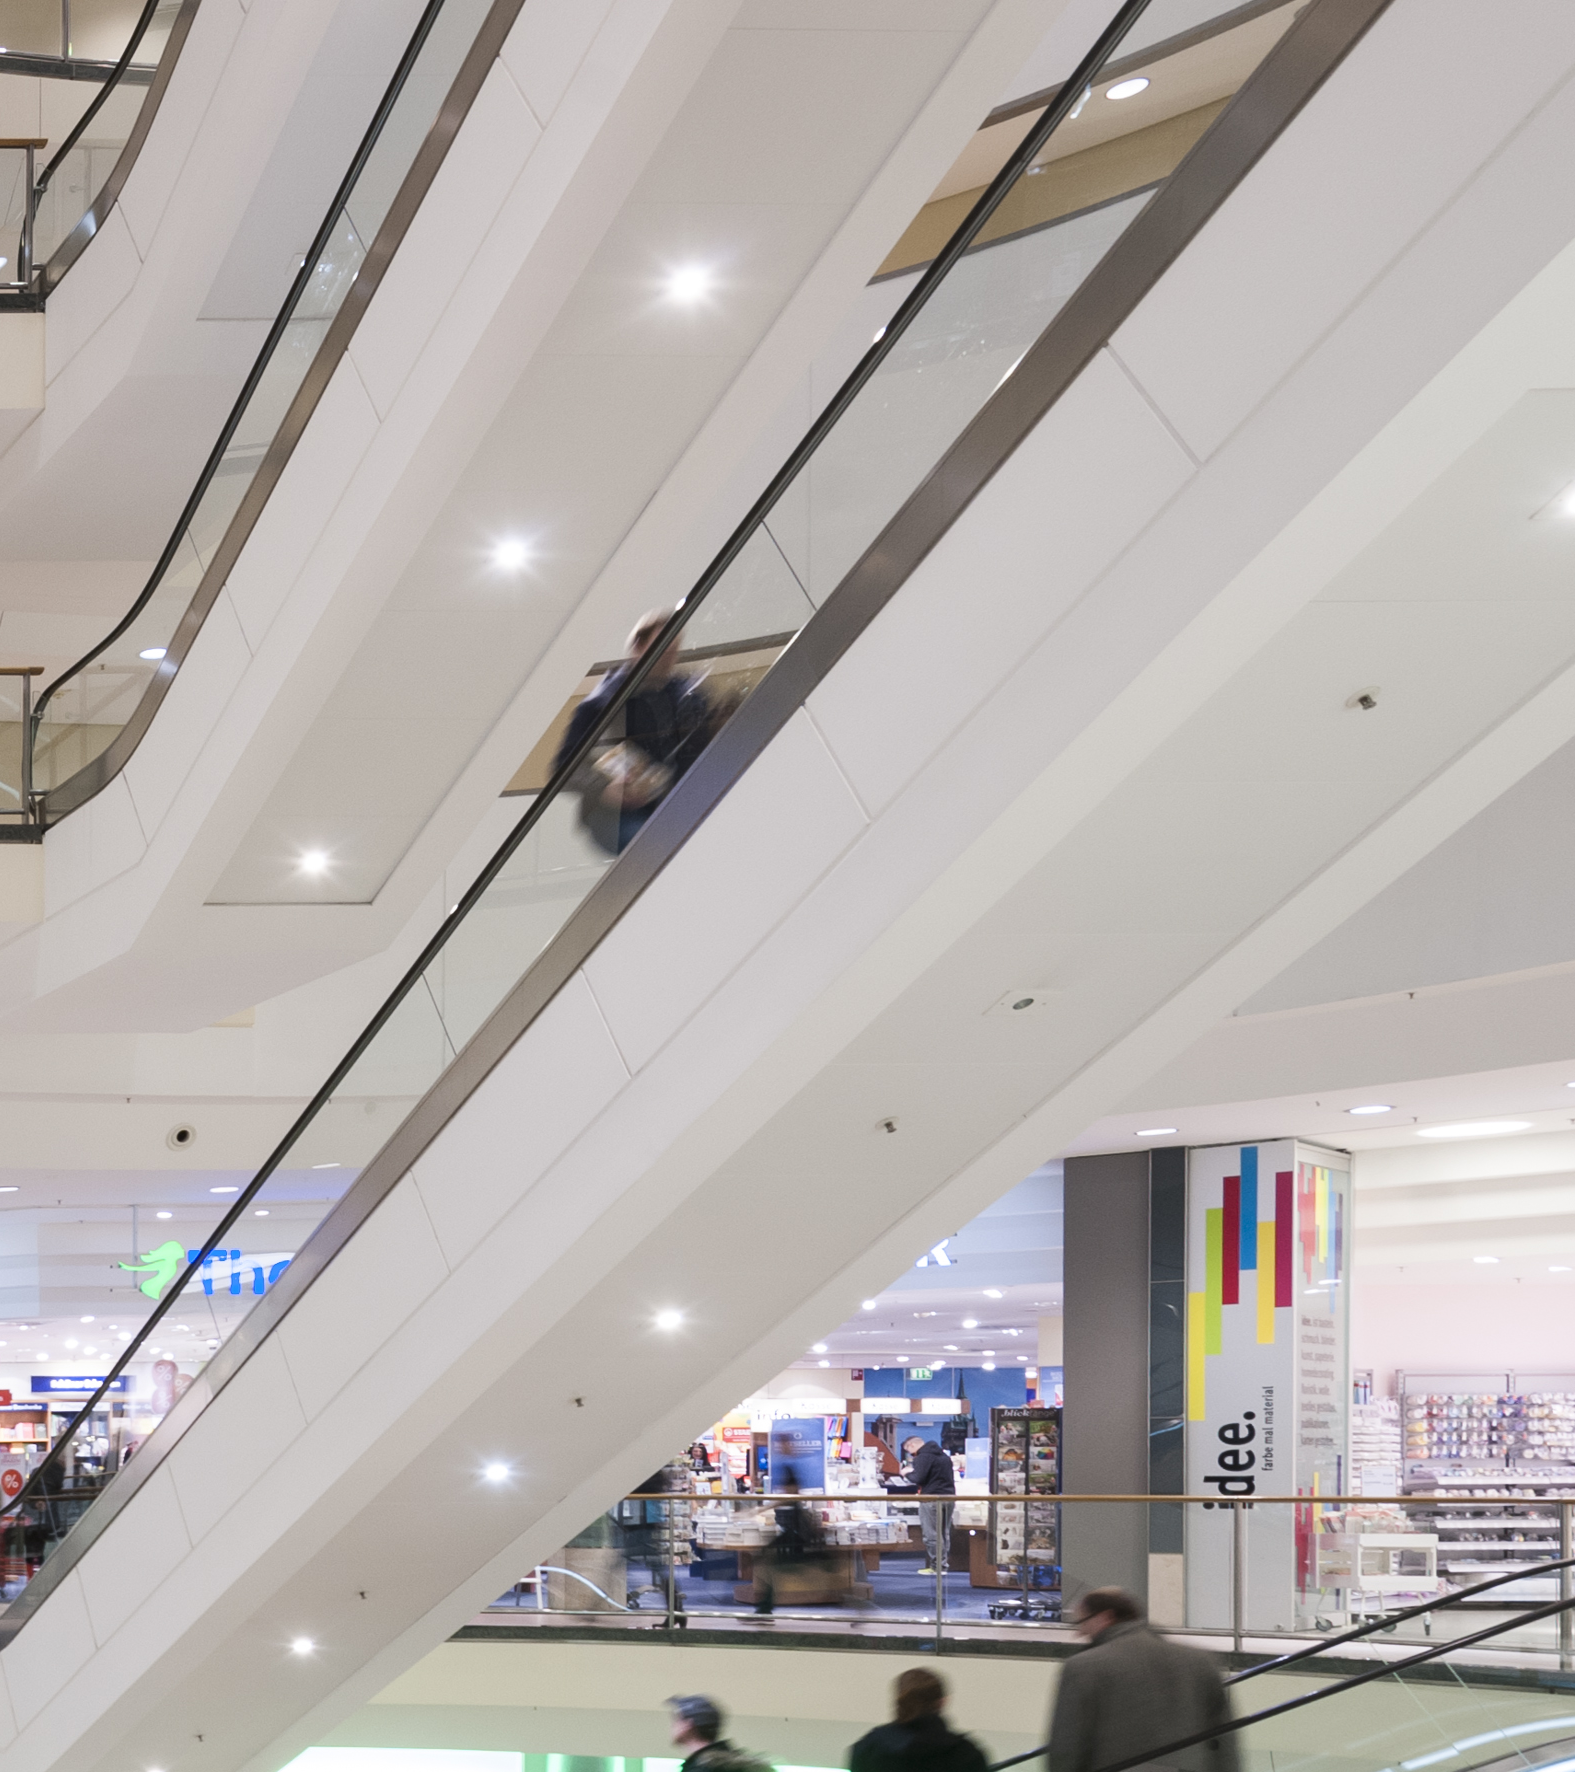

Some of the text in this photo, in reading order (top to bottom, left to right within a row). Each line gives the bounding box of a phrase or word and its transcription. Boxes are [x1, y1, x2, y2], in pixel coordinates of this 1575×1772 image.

[1261, 1386, 1274, 1471] farbe mal material
